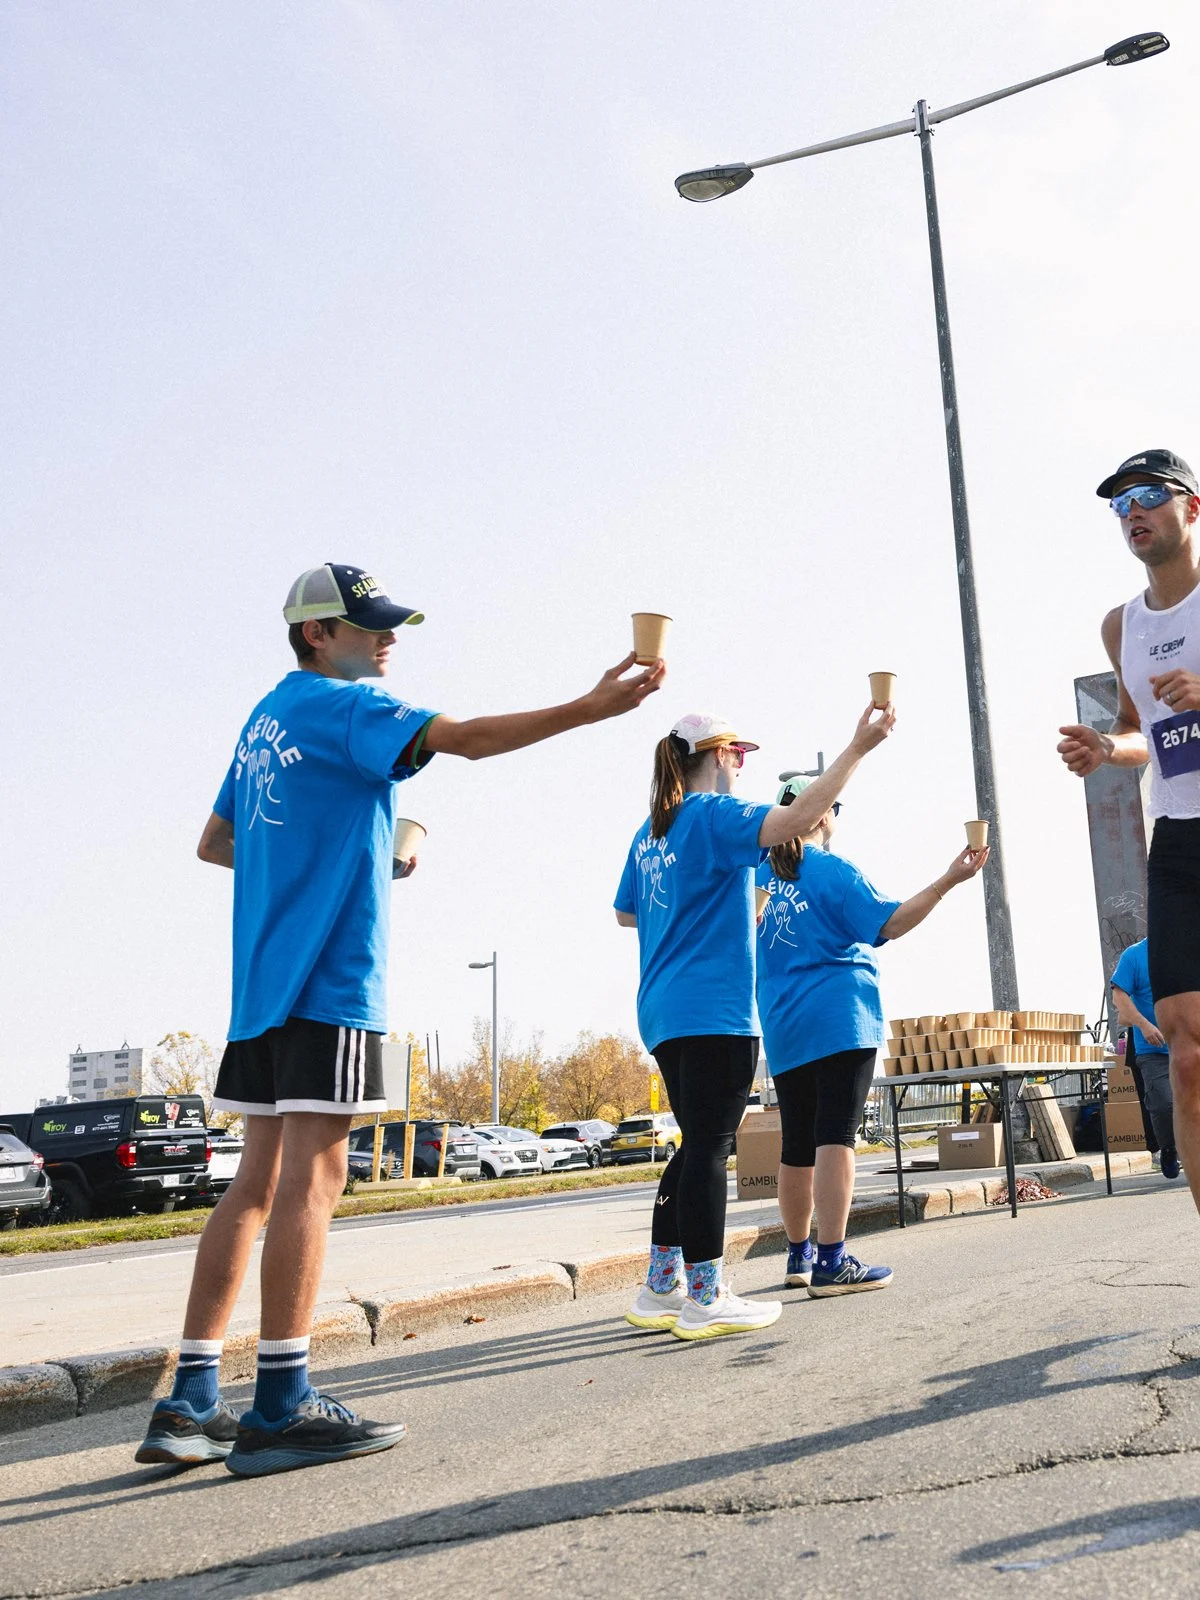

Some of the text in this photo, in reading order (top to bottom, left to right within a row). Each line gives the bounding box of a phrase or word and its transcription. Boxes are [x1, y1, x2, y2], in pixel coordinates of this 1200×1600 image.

[1149, 636, 1185, 656] LE CREW
[761, 877, 809, 914] ÉVOLE
[1110, 1085, 1138, 1094] CAMBI
[740, 1175, 779, 1188] CAMBIU
